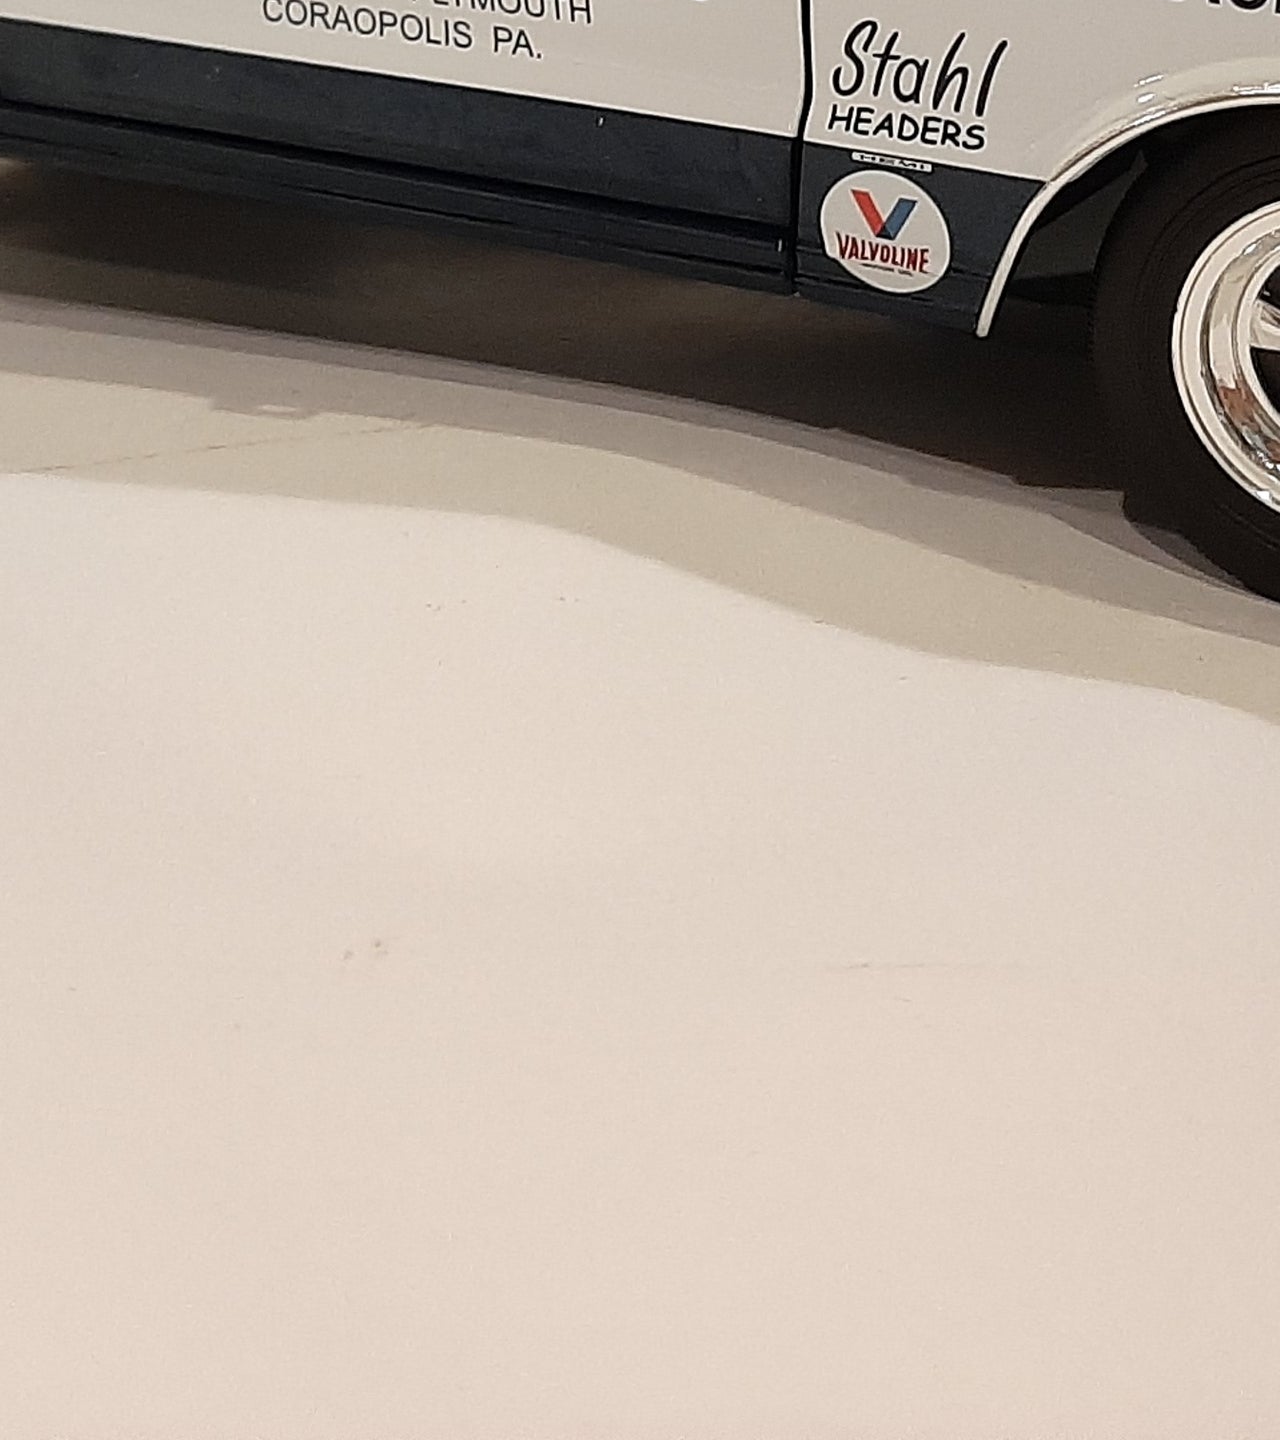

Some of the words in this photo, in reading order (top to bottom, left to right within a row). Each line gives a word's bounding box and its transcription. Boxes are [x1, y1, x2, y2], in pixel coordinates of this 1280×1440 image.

[493, 26, 542, 59] PA.
[832, 20, 1008, 118] Stahl
[827, 103, 985, 151] HEADERS
[835, 230, 929, 274] VALVOLINE
